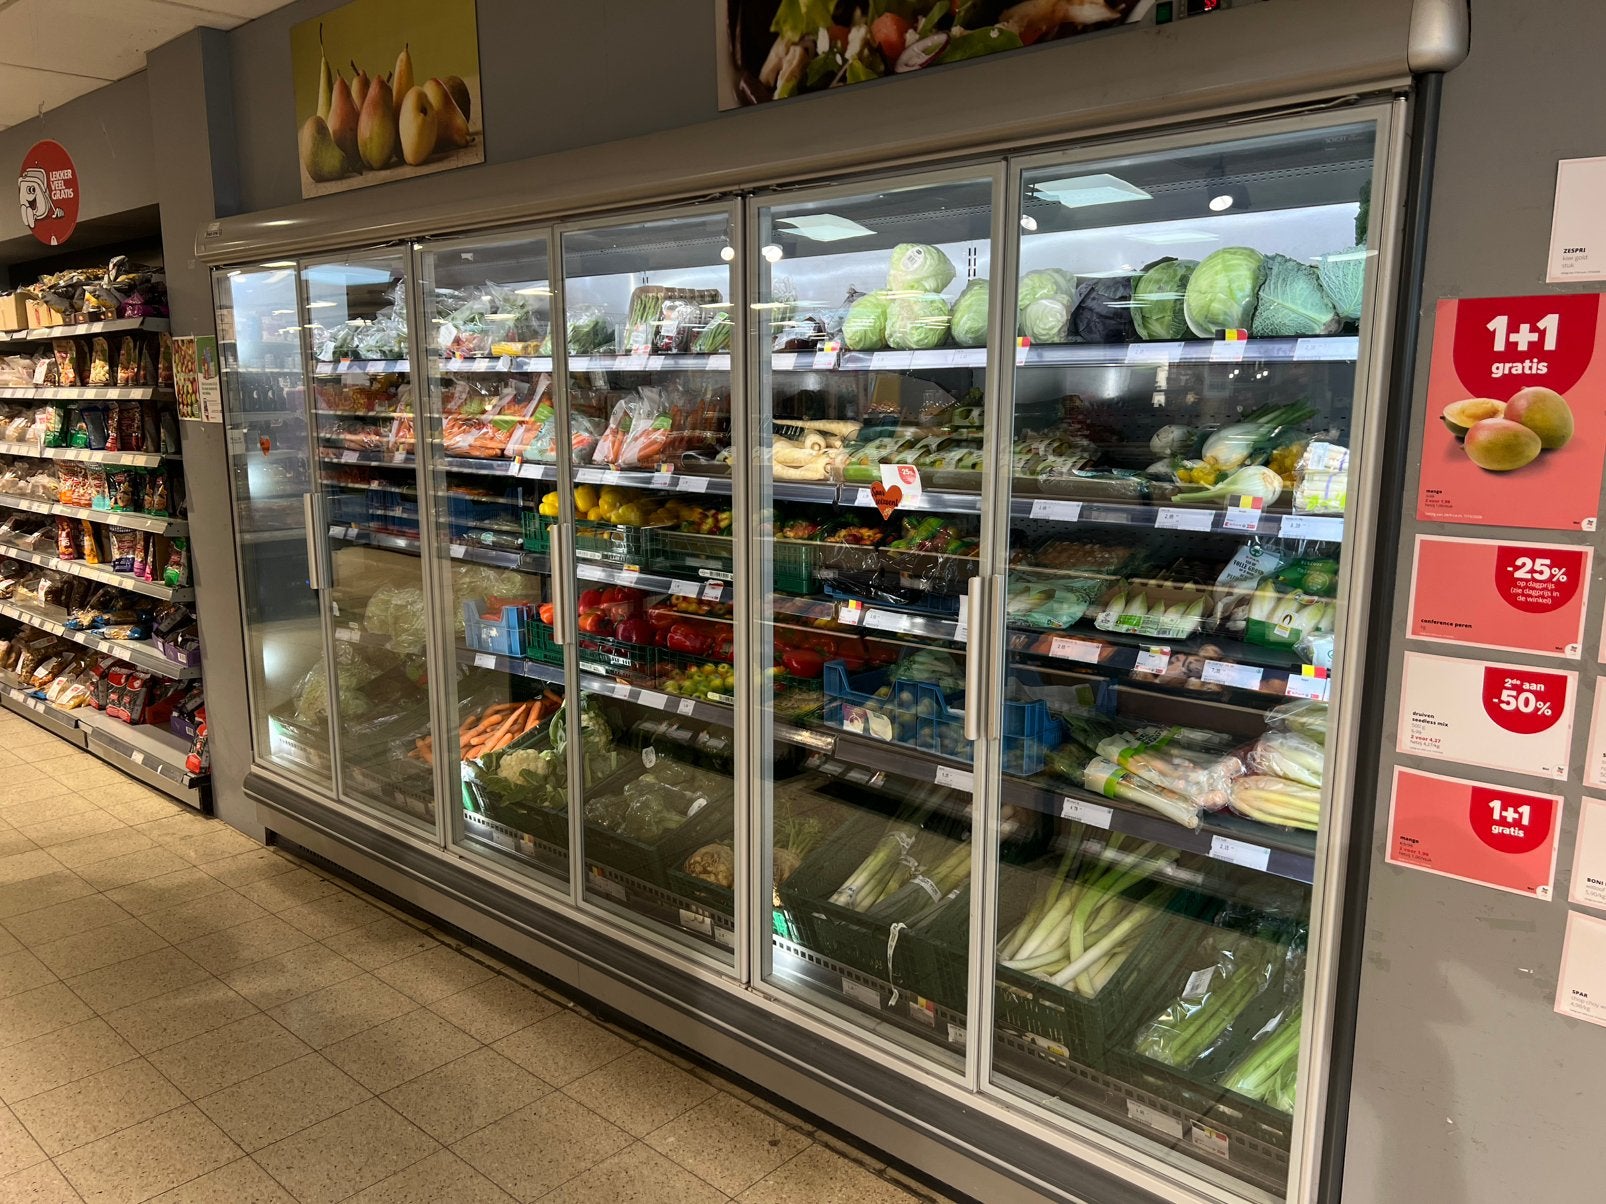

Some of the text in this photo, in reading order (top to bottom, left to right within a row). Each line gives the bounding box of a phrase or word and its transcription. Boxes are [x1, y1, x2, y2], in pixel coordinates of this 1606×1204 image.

[49, 169, 73, 181] LEKKER
[50, 180, 66, 190] VEEL
[51, 188, 74, 200] GRATIS
[1486, 314, 1559, 351] 1+1
[1491, 358, 1548, 378] gratis
[1507, 556, 1568, 582] -25%
[1516, 580, 1555, 590] op dagprijs
[1523, 588, 1552, 597] dagprijs
[1526, 596, 1552, 605] winkel)
[1420, 618, 1453, 627] conference
[1504, 678, 1545, 692] 2de aan
[1492, 689, 1552, 716] -50%
[1412, 711, 1435, 719] druiven
[1412, 717, 1437, 726] seedless
[1488, 799, 1531, 825] 1+1
[1491, 825, 1525, 837] gratis
[1400, 835, 1420, 844] mango
[1587, 877, 1604, 886] BONI
[1572, 989, 1588, 998] SPAR
